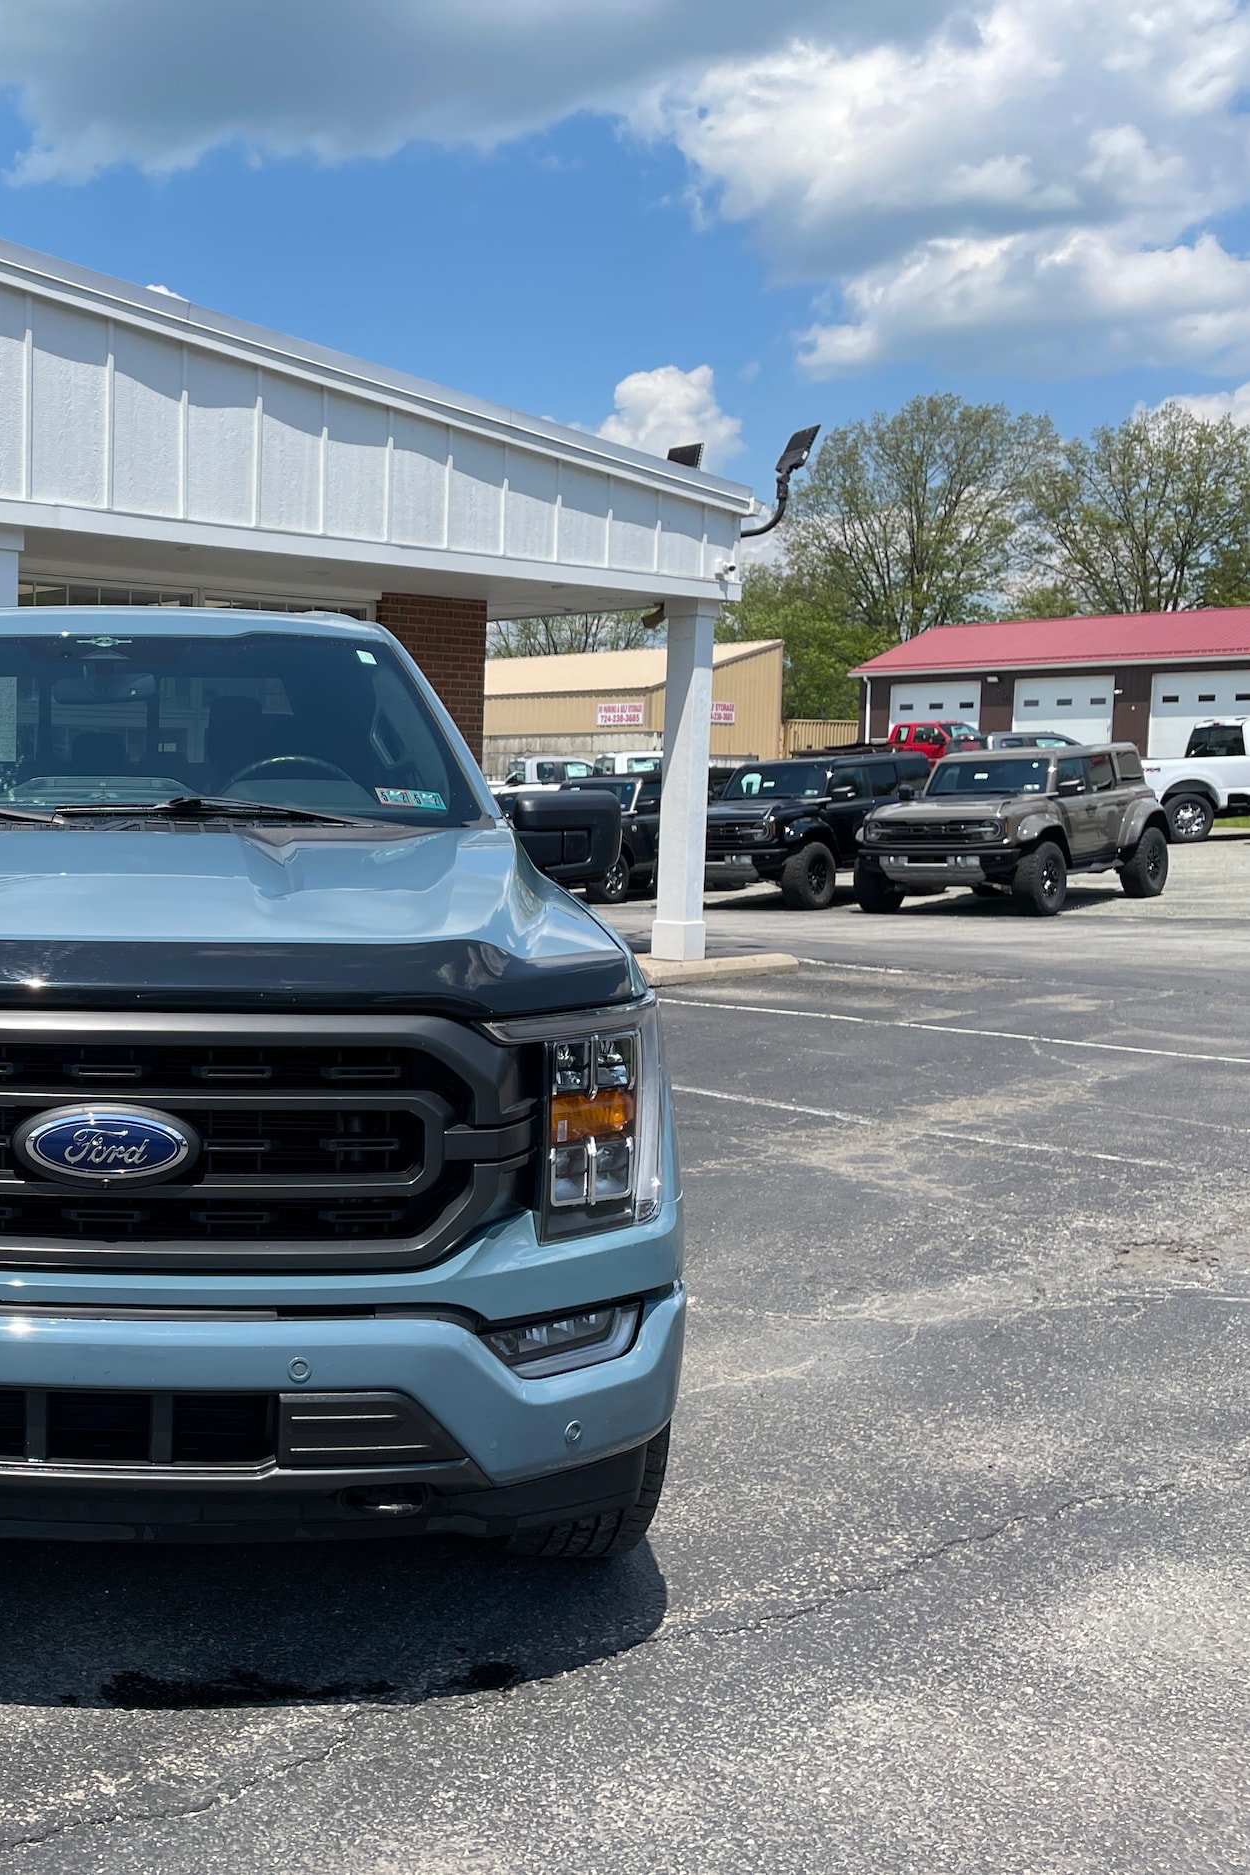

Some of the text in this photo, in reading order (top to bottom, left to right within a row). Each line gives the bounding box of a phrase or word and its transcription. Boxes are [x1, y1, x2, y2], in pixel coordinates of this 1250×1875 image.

[380, 791, 389, 802] 5
[413, 793, 422, 804] 5
[64, 1128, 150, 1165] Ford
